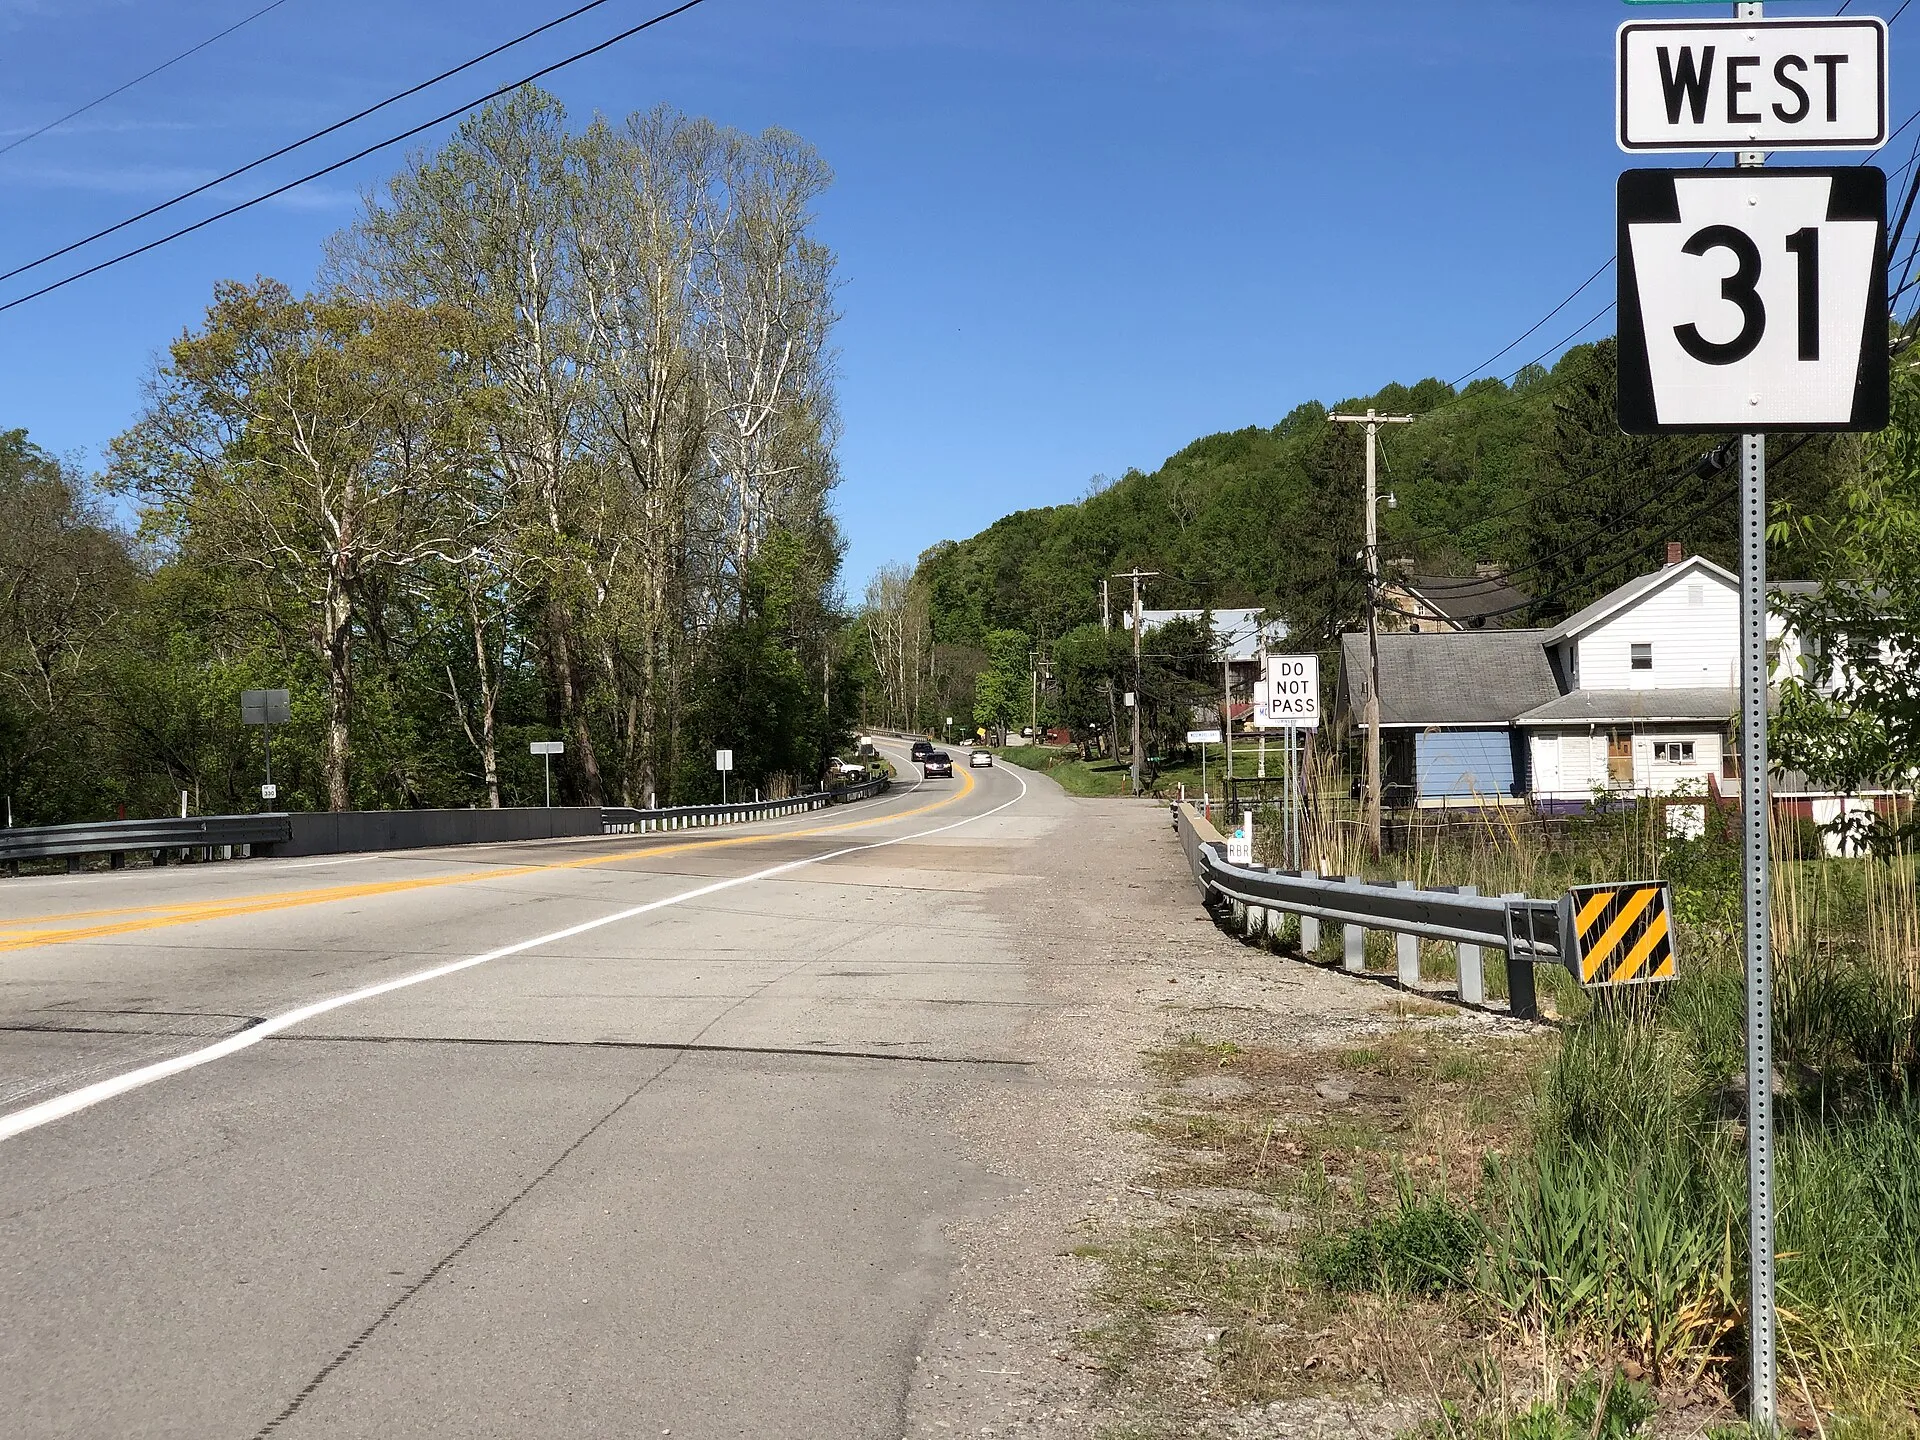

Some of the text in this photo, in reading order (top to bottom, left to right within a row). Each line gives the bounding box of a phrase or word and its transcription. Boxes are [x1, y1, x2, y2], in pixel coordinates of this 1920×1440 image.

[1655, 45, 1849, 125] WEST
[1672, 223, 1820, 366] 31
[1281, 662, 1304, 676] DO
[1276, 680, 1309, 694] NOT
[1272, 698, 1315, 713] PASS
[1229, 844, 1249, 857] RBR
